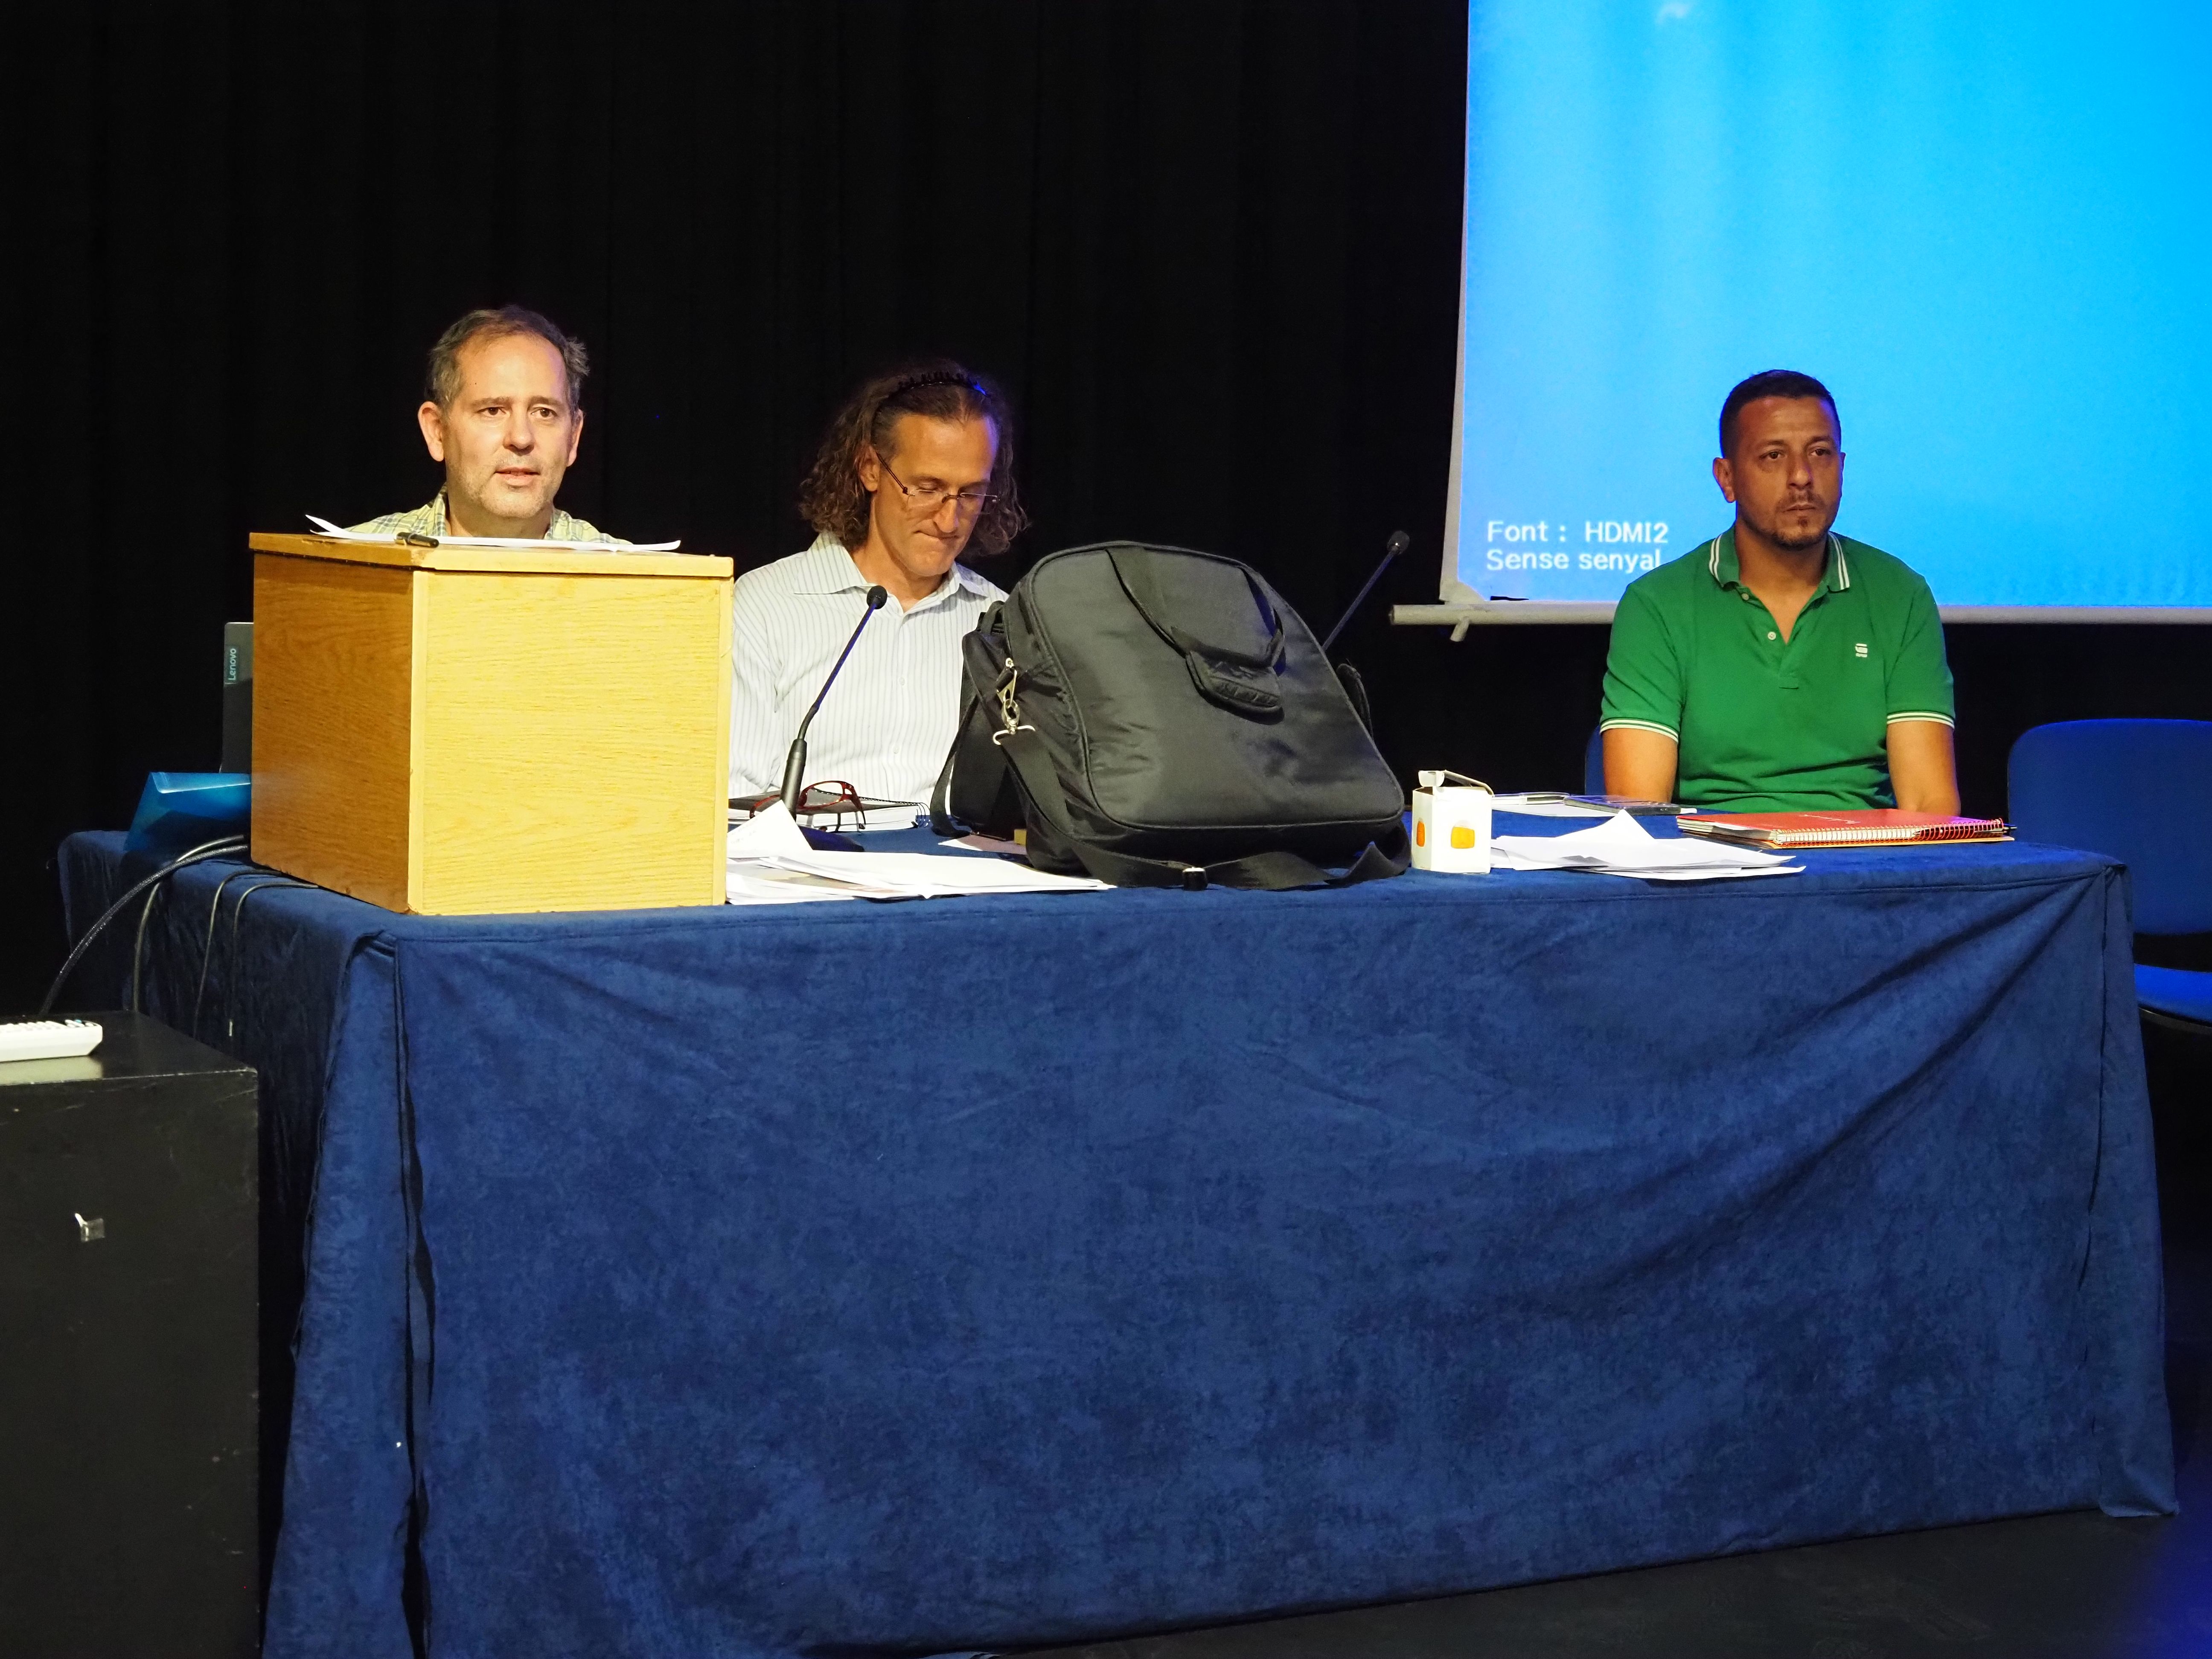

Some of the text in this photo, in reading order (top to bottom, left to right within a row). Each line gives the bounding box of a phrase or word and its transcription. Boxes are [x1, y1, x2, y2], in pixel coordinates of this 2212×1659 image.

[1487, 521, 1548, 542] Font
[1585, 521, 1668, 543] HDMI2
[1487, 548, 1661, 574] Sense senyal
[228, 648, 236, 681] Lenovo
